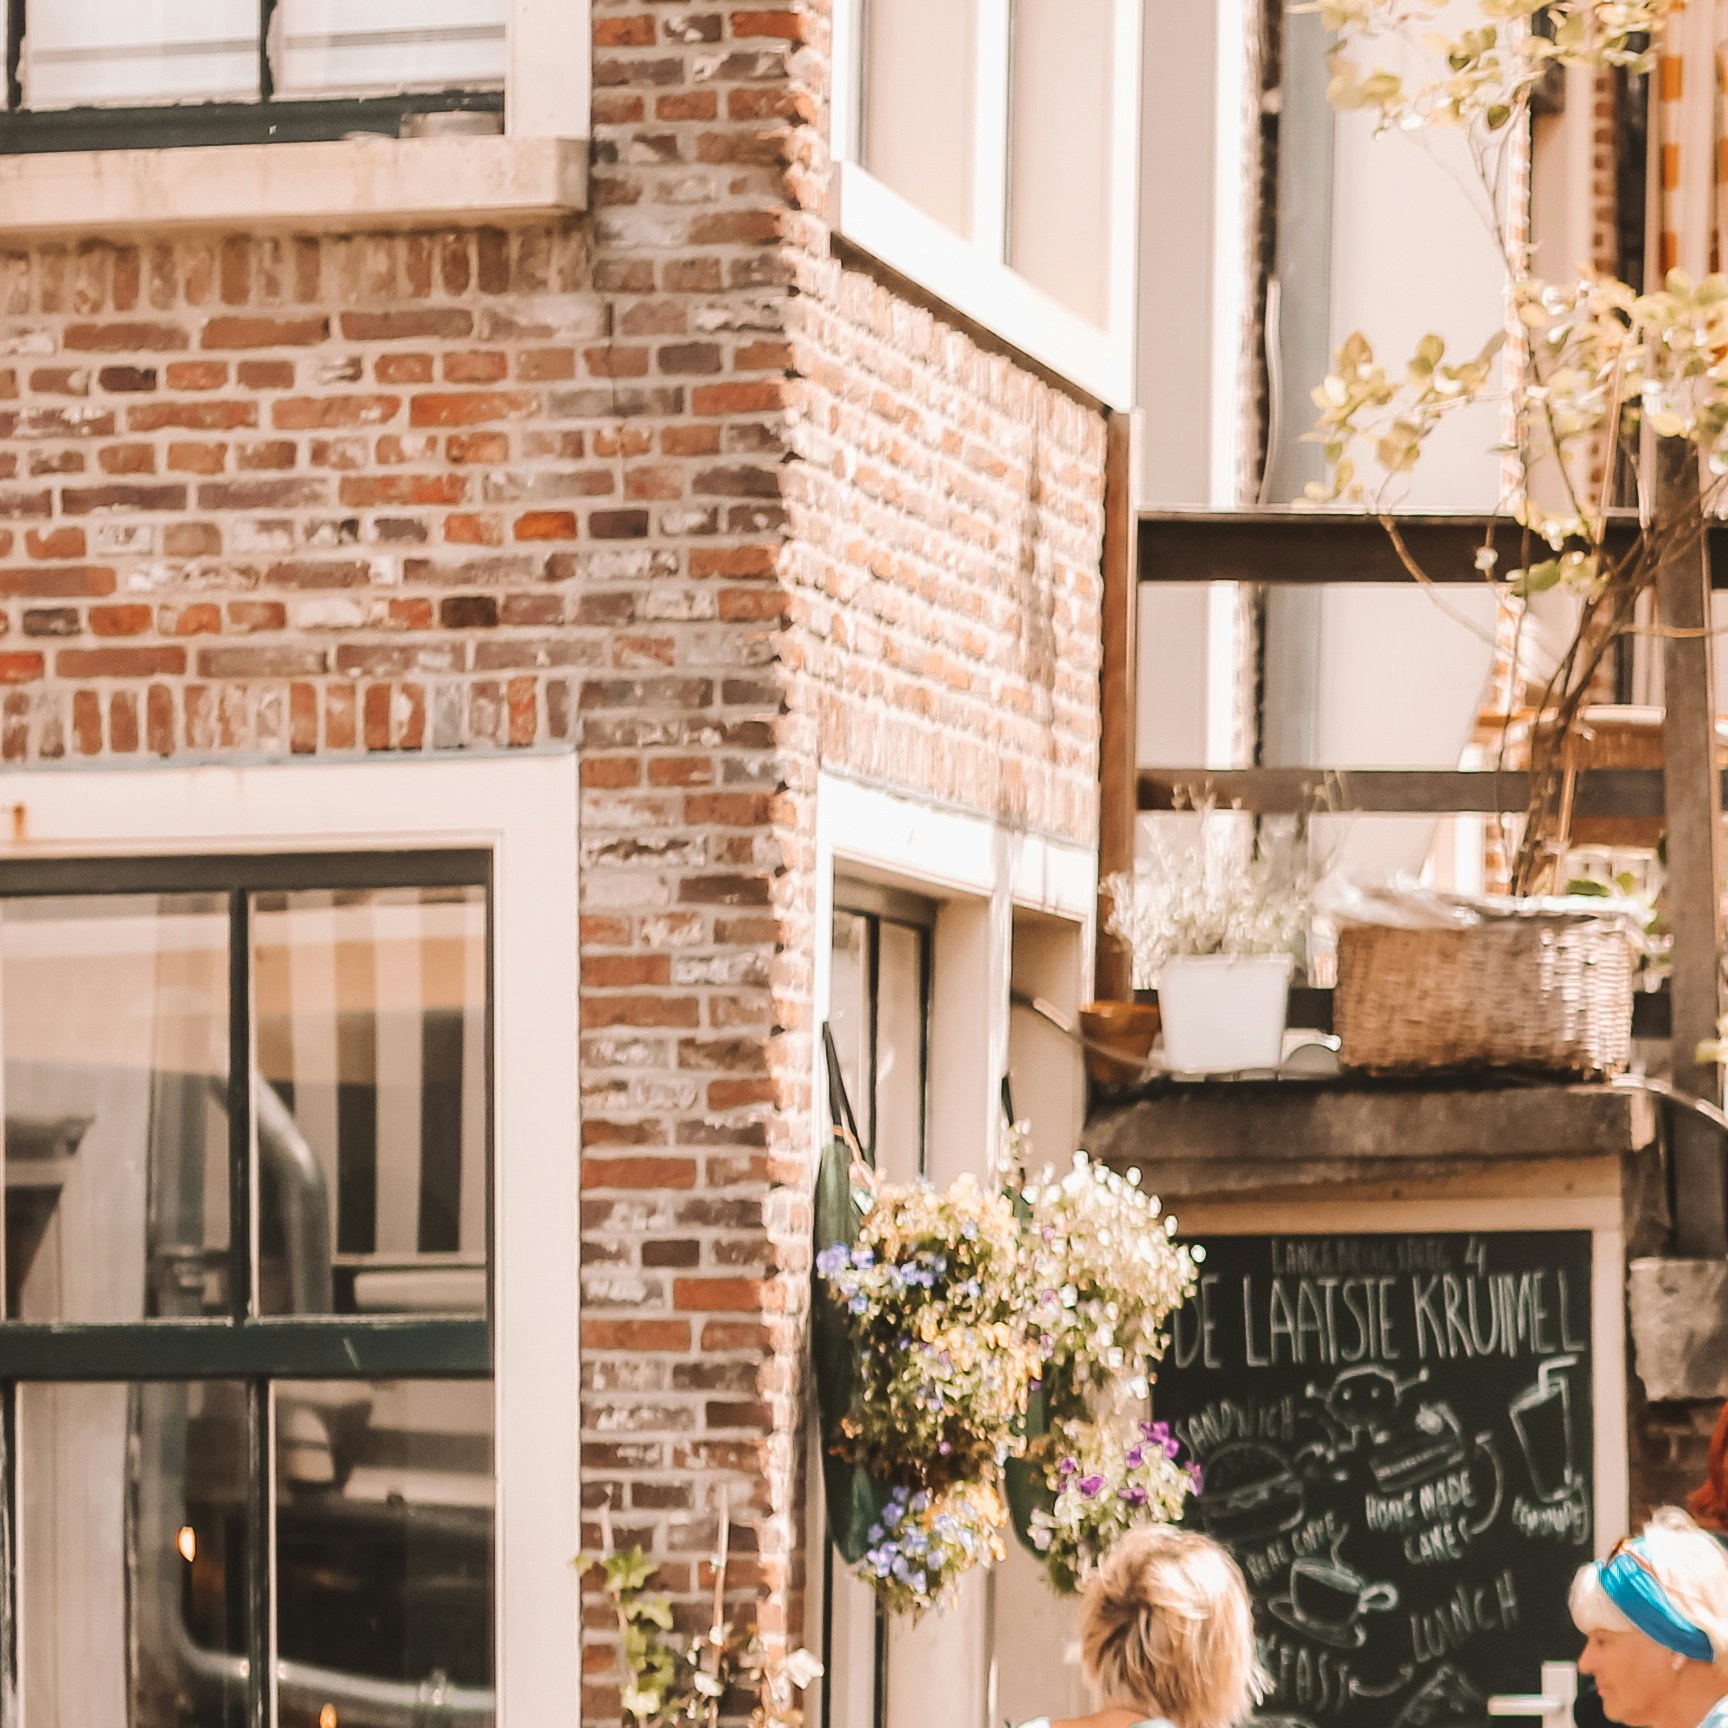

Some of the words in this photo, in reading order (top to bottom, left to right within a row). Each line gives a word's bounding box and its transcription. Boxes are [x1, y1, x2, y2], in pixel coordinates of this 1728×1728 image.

[1463, 1235, 1488, 1278] 4
[1173, 1272, 1222, 1369] DE
[1243, 1273, 1399, 1368] LAATSTE
